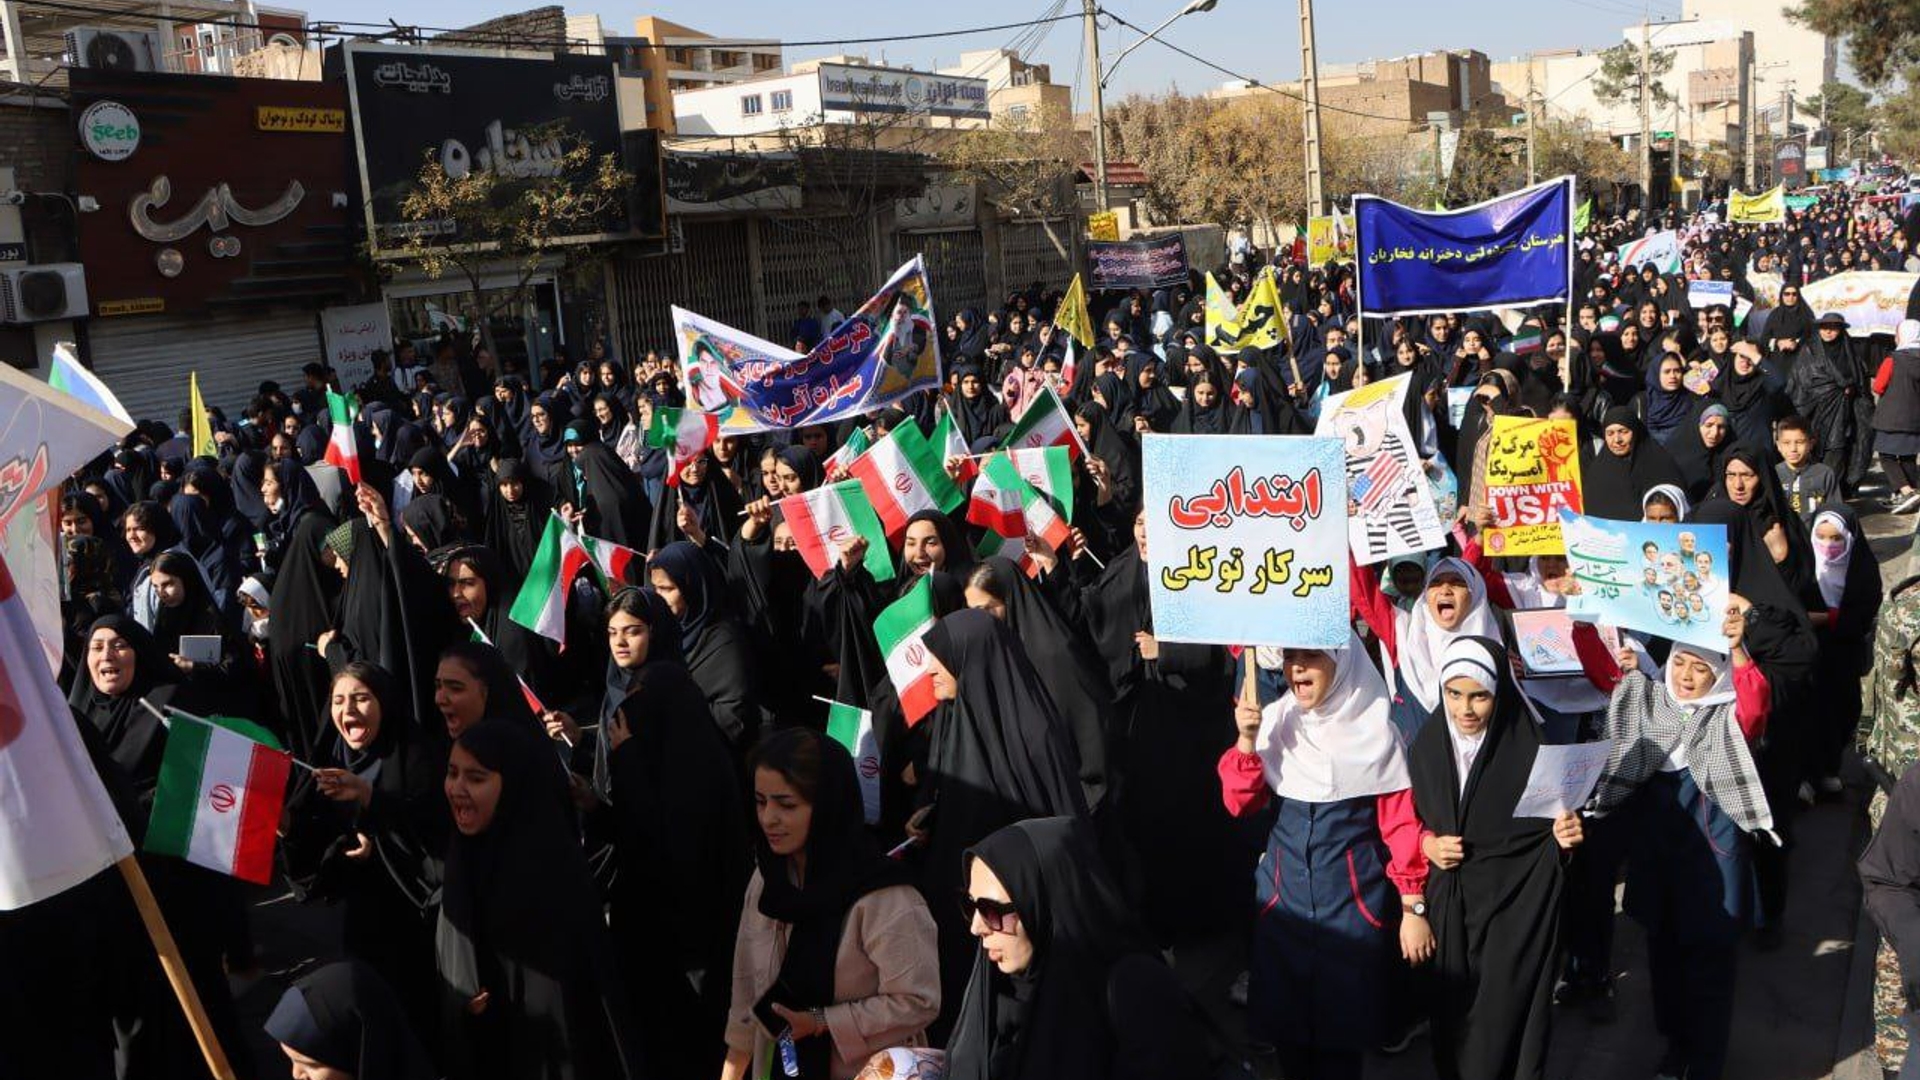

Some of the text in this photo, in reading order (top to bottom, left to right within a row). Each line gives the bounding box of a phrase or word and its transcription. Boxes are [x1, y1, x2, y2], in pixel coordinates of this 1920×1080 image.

[374, 63, 450, 94] بدلیجات
[261, 111, 287, 127] نوجوان
[296, 111, 317, 128] کودک
[320, 113, 342, 129] پوشاک
[92, 122, 138, 142] seeb
[440, 120, 563, 179] ستاره
[130, 175, 306, 278] سیب
[1519, 233, 1566, 252] هنرستان
[1417, 246, 1462, 264] دخترانه
[1501, 436, 1535, 460] مرگ
[1489, 455, 1544, 484] آمریکا
[1169, 465, 1323, 531] ابتدایی
[1488, 481, 1571, 497] DOWN WITH
[1488, 492, 1574, 528] USA
